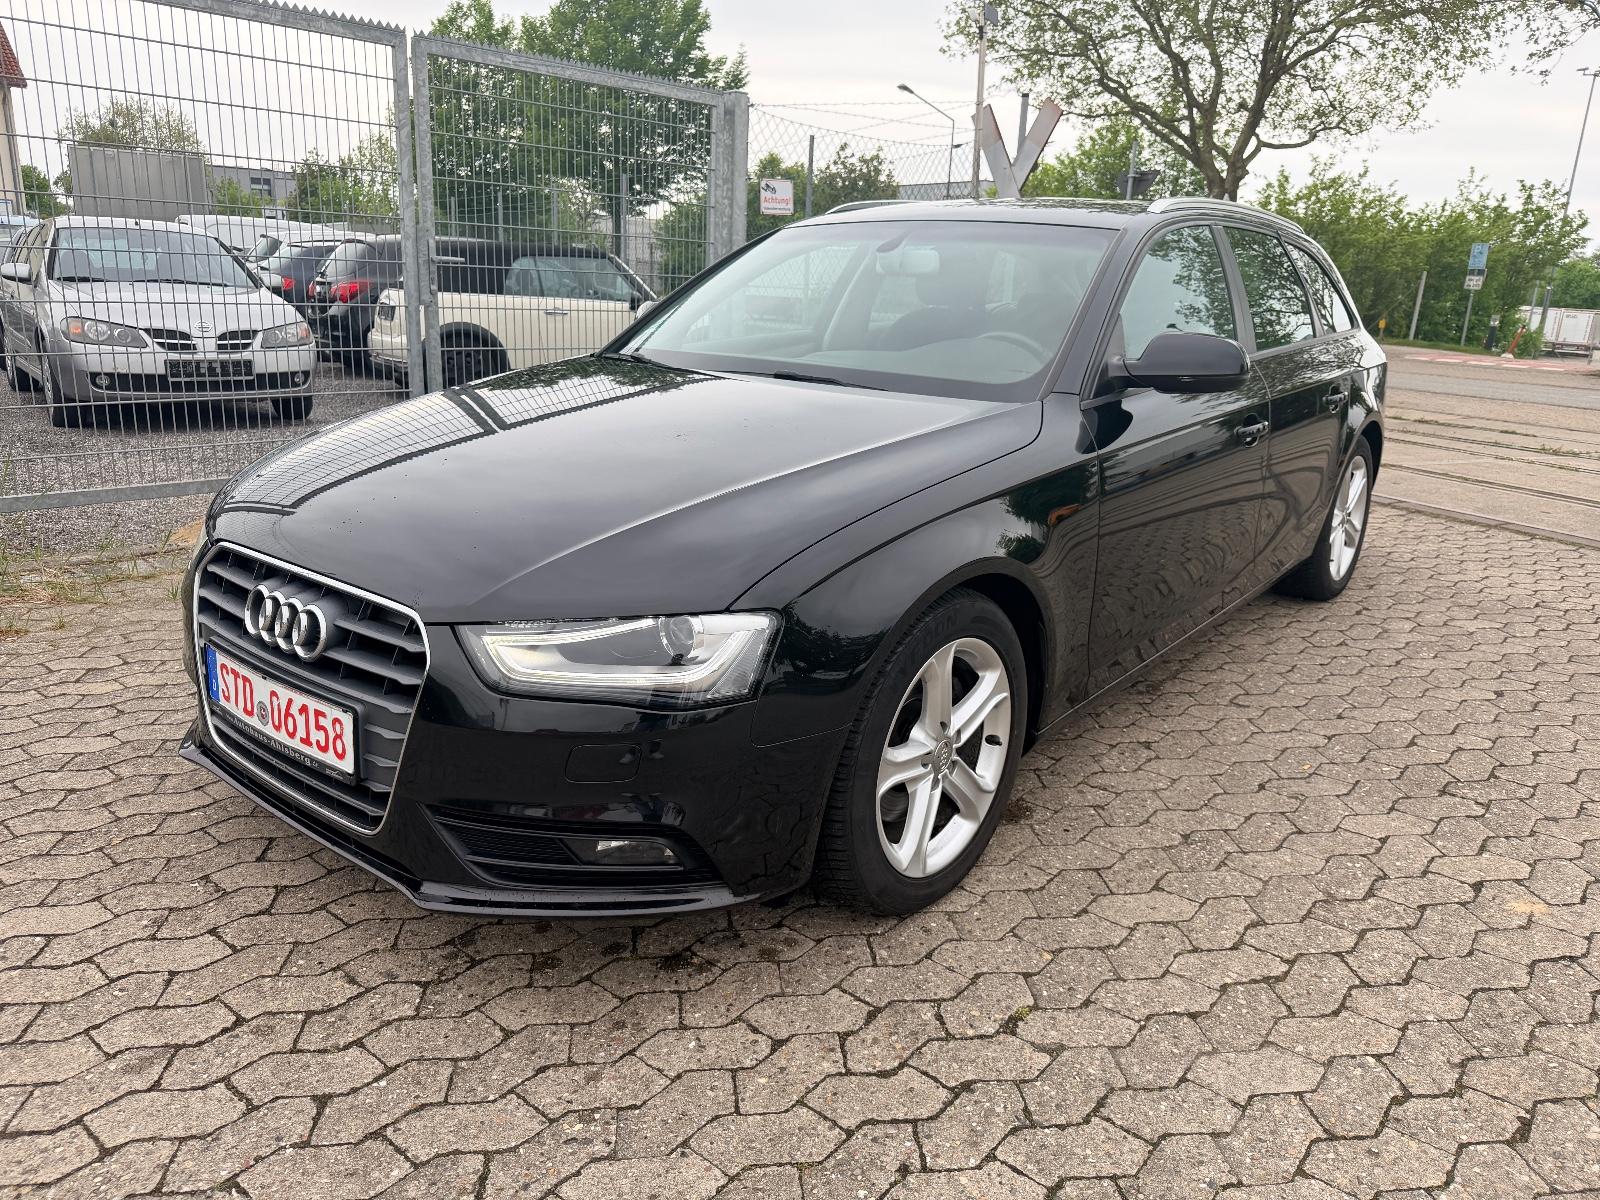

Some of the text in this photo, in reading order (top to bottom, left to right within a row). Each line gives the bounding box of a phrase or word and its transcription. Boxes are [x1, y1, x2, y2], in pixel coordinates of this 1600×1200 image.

[763, 195, 791, 206] Achtung!
[219, 662, 347, 761] STD 06158
